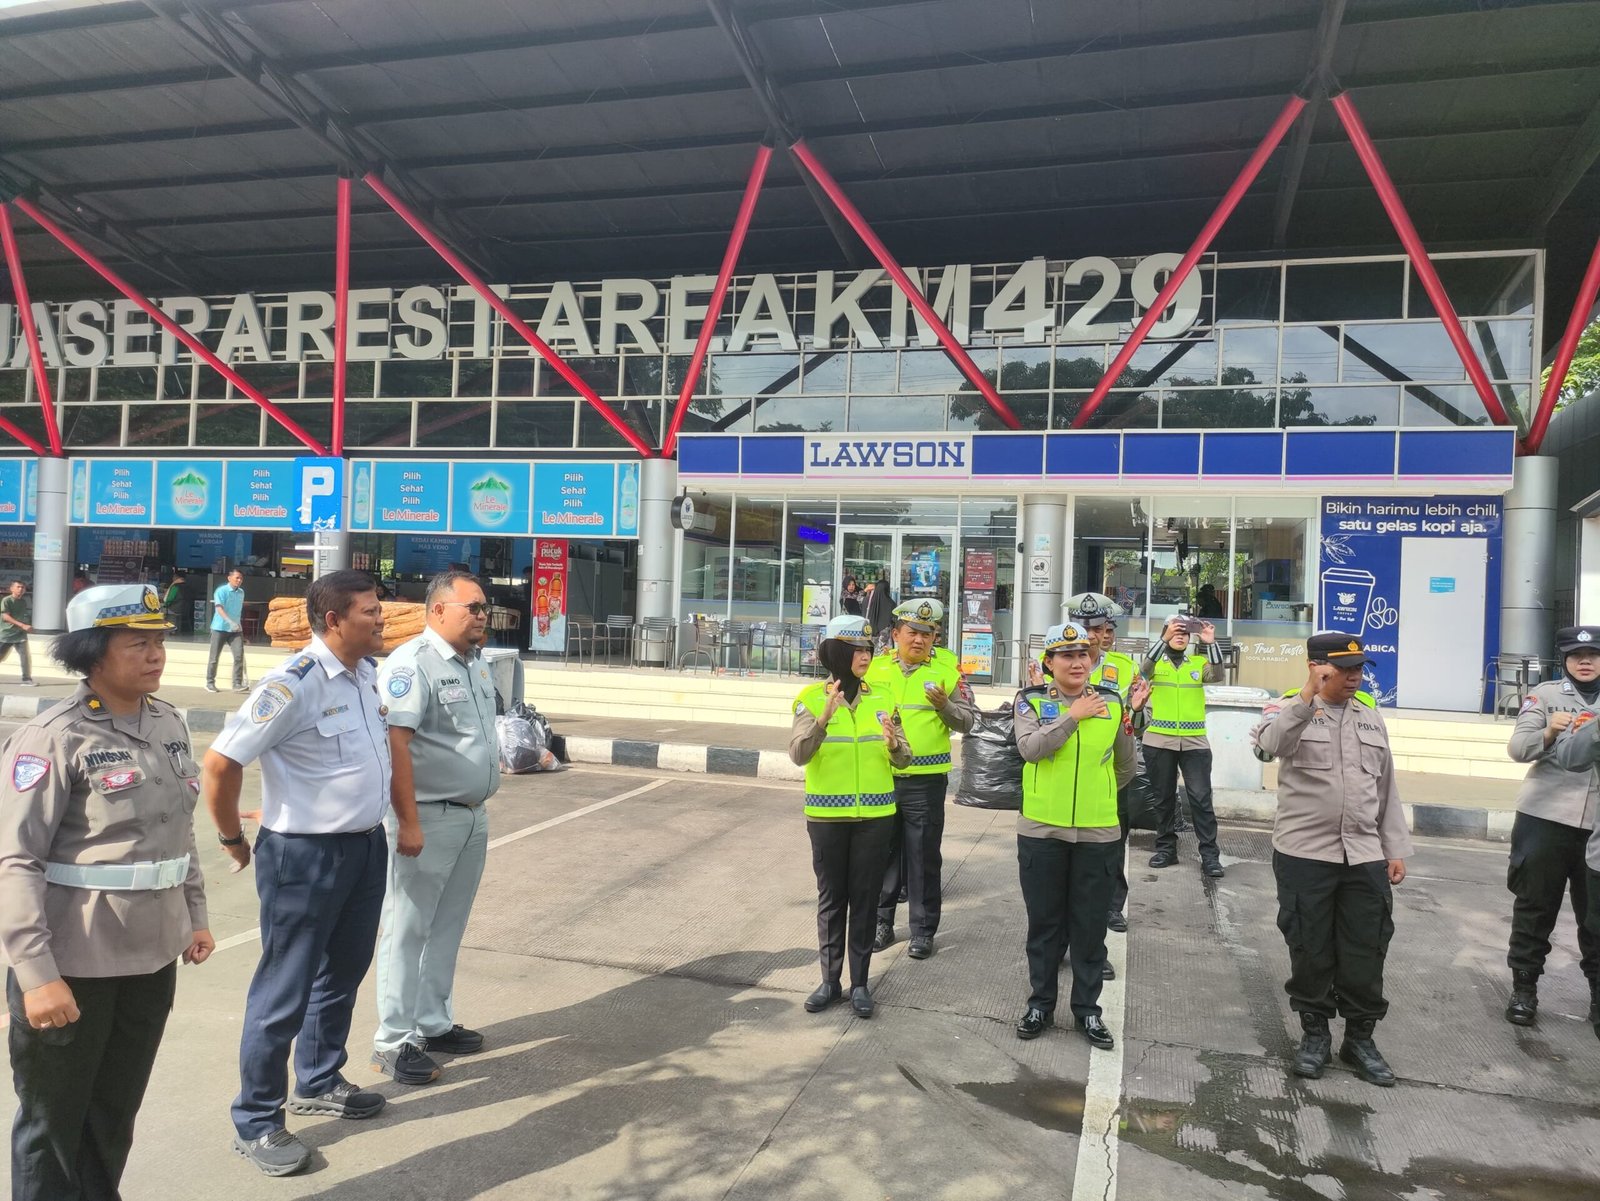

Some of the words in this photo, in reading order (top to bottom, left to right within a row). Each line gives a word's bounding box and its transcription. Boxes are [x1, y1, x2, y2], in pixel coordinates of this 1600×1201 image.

[286, 284, 511, 364] REST
[531, 274, 799, 357] AREA
[814, 264, 971, 349] KM
[983, 252, 1202, 343] 429
[810, 442, 965, 468] LAWSON
[253, 470, 270, 478] Pilih
[403, 472, 421, 480] Pilih
[564, 473, 584, 482] Pilih
[111, 480, 132, 488] Sehat
[250, 482, 272, 490] Sehat
[400, 484, 423, 493] Sehat
[113, 491, 129, 499] Pilih
[561, 486, 586, 495] Sehat
[252, 493, 270, 501] Pilih
[301, 466, 335, 525] P
[402, 496, 420, 505] Pilih
[563, 499, 583, 508] Pilih
[473, 502, 507, 511] Minerale
[1326, 502, 1362, 515] Bikin
[1367, 503, 1419, 516] harimu
[1424, 503, 1461, 516] lebih
[1466, 504, 1499, 518] chill,
[235, 505, 246, 517] Le
[247, 506, 287, 518] Minerale
[383, 509, 395, 521] Le
[397, 510, 439, 521] Minerale
[543, 511, 556, 524] Le
[558, 512, 603, 525] Minerale
[1339, 519, 1371, 532] satu
[1376, 519, 1417, 533] gelas
[1421, 520, 1456, 534] kopi
[1460, 520, 1487, 534] aja.
[1254, 643, 1275, 654] True
[1280, 643, 1304, 656] Taste
[441, 678, 460, 686] BIMO
